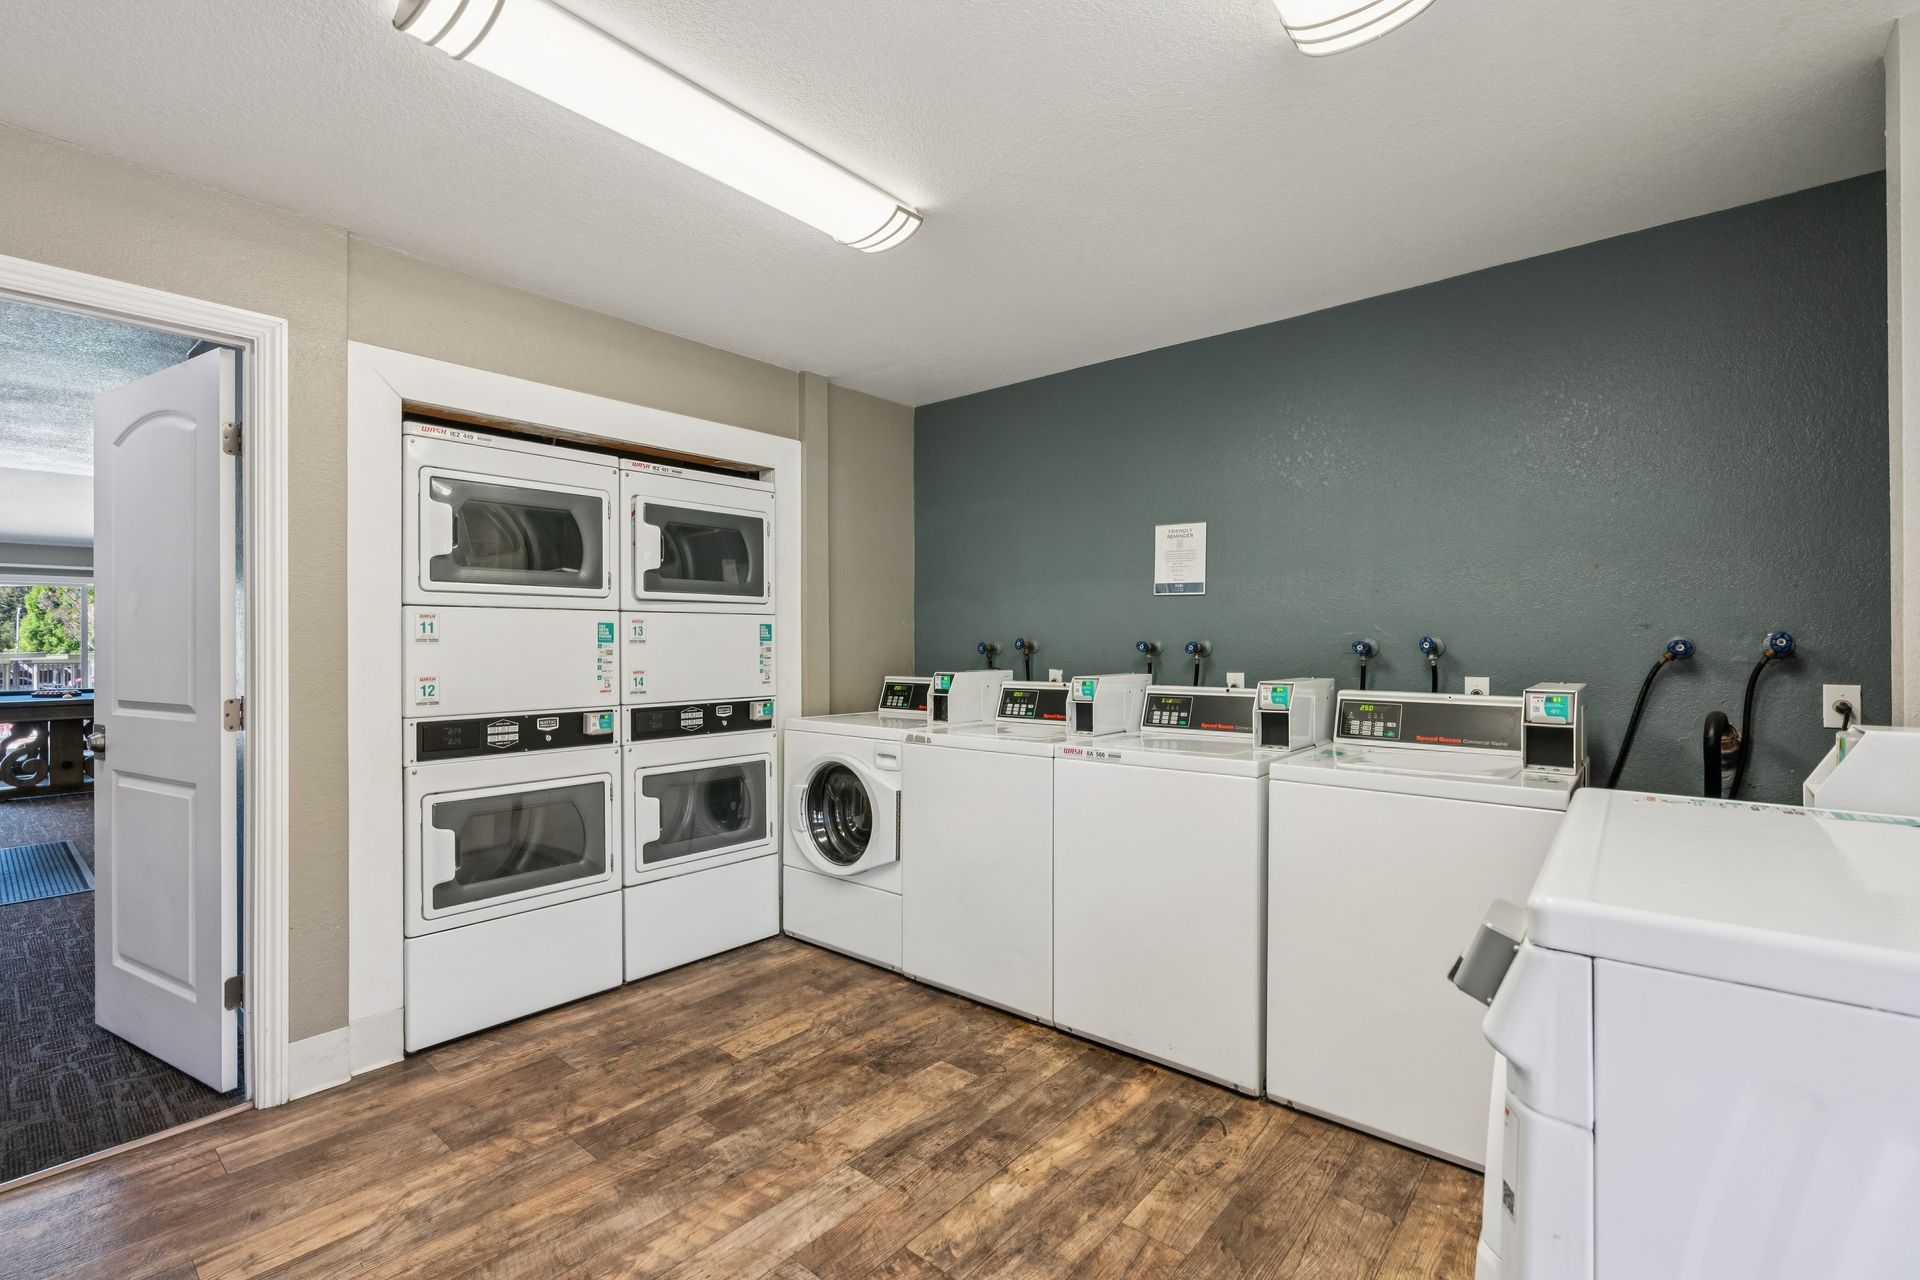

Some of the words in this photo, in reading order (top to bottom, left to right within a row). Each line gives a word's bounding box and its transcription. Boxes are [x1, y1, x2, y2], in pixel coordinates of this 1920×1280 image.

[420, 621, 434, 634] 11
[632, 625, 644, 636] 13
[633, 676, 644, 687] 14
[420, 684, 435, 697] 12
[1359, 704, 1375, 712] 250
